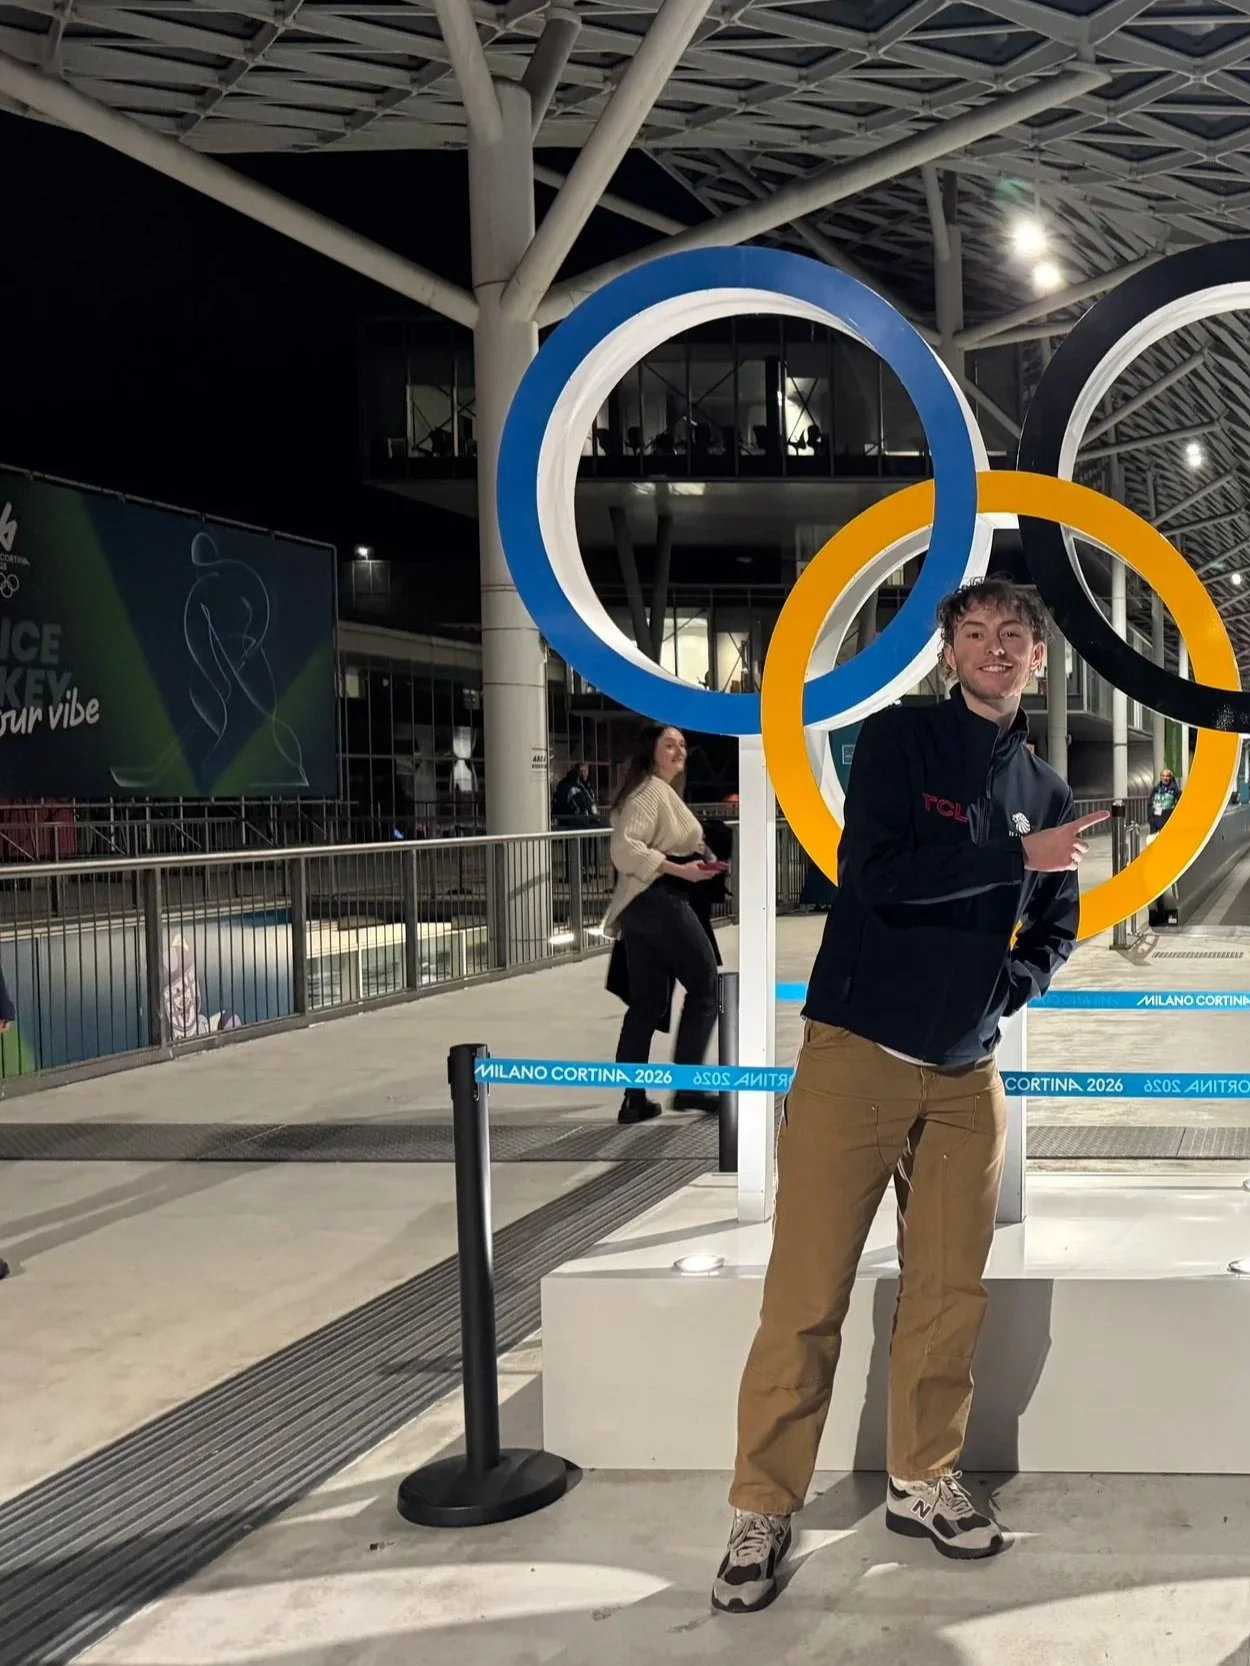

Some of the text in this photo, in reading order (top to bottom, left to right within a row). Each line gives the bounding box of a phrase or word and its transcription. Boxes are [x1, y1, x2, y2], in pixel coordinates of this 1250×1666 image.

[1, 617, 61, 664] ICE
[0, 665, 72, 708] KEY
[48, 687, 100, 730] vibe
[923, 792, 969, 823] TCL
[1137, 994, 1194, 1007] MILANO
[474, 1064, 673, 1085] MILANO CORTINA 2026
[1005, 1076, 1124, 1093] CORTINA 2026
[911, 1498, 931, 1519] N
